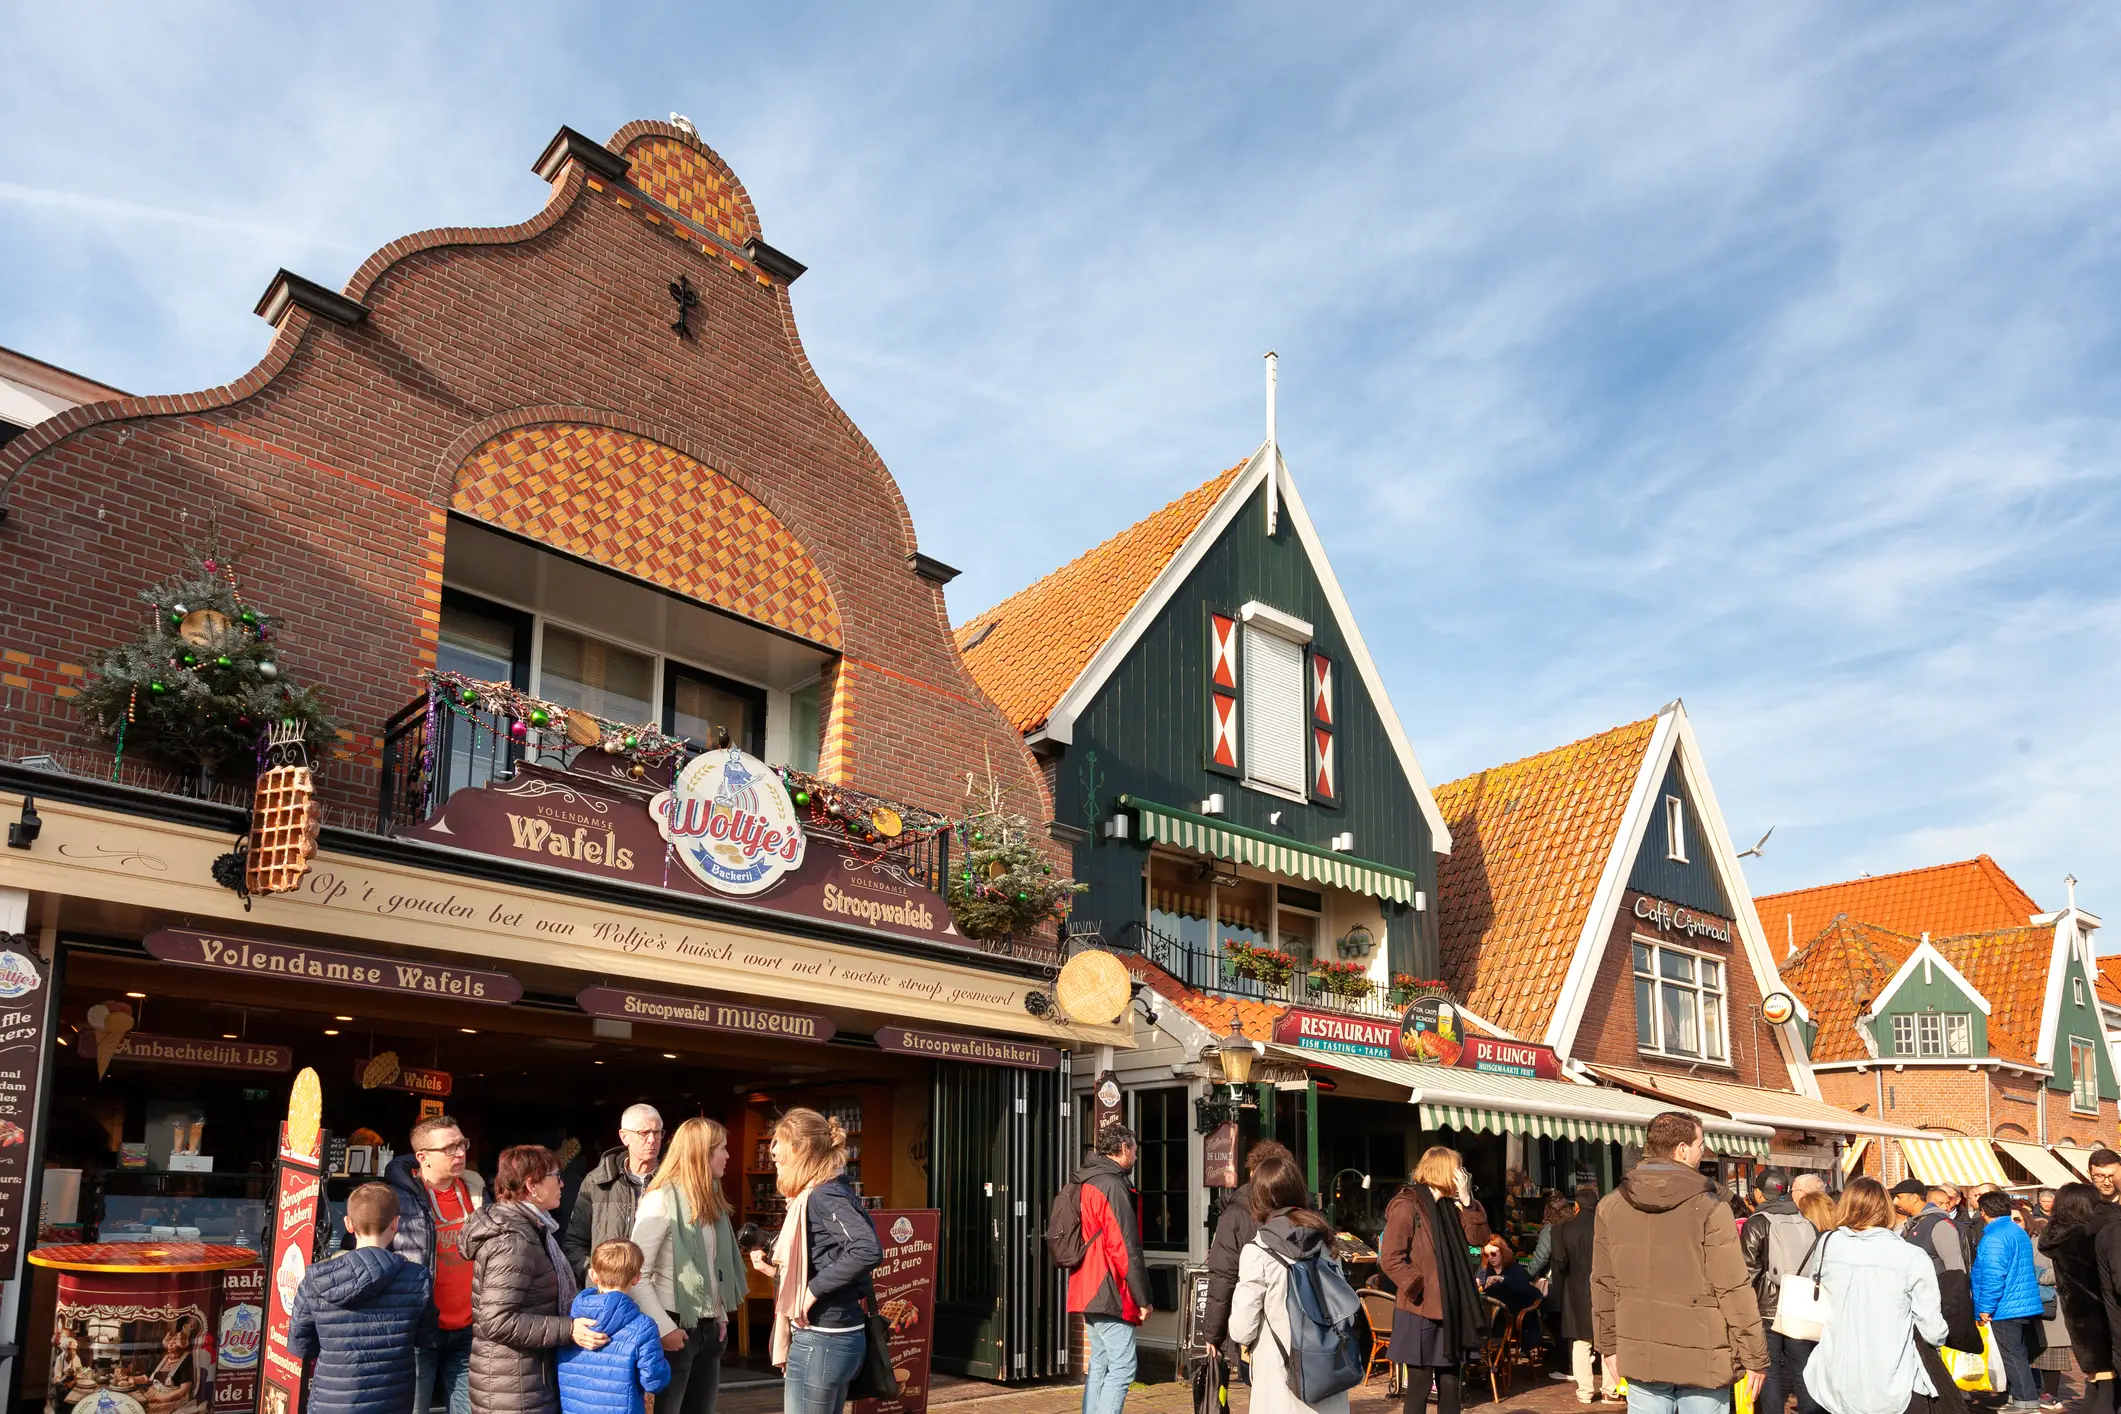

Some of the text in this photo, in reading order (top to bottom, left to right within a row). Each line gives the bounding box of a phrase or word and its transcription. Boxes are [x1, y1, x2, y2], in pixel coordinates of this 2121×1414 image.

[537, 805, 614, 830] VOLENDAMSE
[658, 798, 798, 862] Woltje's
[506, 812, 634, 871] Wafels
[711, 863, 753, 881] Backerij
[850, 876, 907, 894] VOLENDAMSE
[823, 883, 934, 930] Stroopwafels
[1635, 897, 1731, 942] Café Centraal
[310, 872, 350, 904] Op
[377, 896, 480, 919] gouden
[488, 904, 526, 928] bet
[536, 919, 577, 936] van
[592, 922, 670, 952] Woltje's
[676, 936, 735, 961] huisch
[743, 953, 784, 969] wort
[791, 961, 823, 976] met
[842, 967, 892, 986] soetste
[899, 978, 943, 1000] stroop
[946, 991, 1015, 1006] gesmeerd
[199, 938, 485, 997] Volendamse Wafels
[0, 1012, 31, 1028] ffle
[624, 995, 710, 1021] Stroopwafel
[1300, 1016, 1392, 1046] RESTAURANT
[115, 1038, 278, 1066] Ambachtelijk IJS
[903, 1032, 1040, 1064] Stroopwafelbakkerij
[1301, 1039, 1388, 1057] FISH TASTING TAPAS
[1477, 1043, 1537, 1066] DE LUNCH
[404, 1072, 442, 1091] Wafels
[1479, 1062, 1535, 1077] HUISGEMAAKTE FRIET
[281, 1180, 320, 1210] Stroopwafel
[283, 1203, 313, 1230] Bakkerij
[900, 1240, 933, 1255] waffles
[870, 1257, 922, 1279] rom 2 euro
[912, 1277, 930, 1287] Waffles
